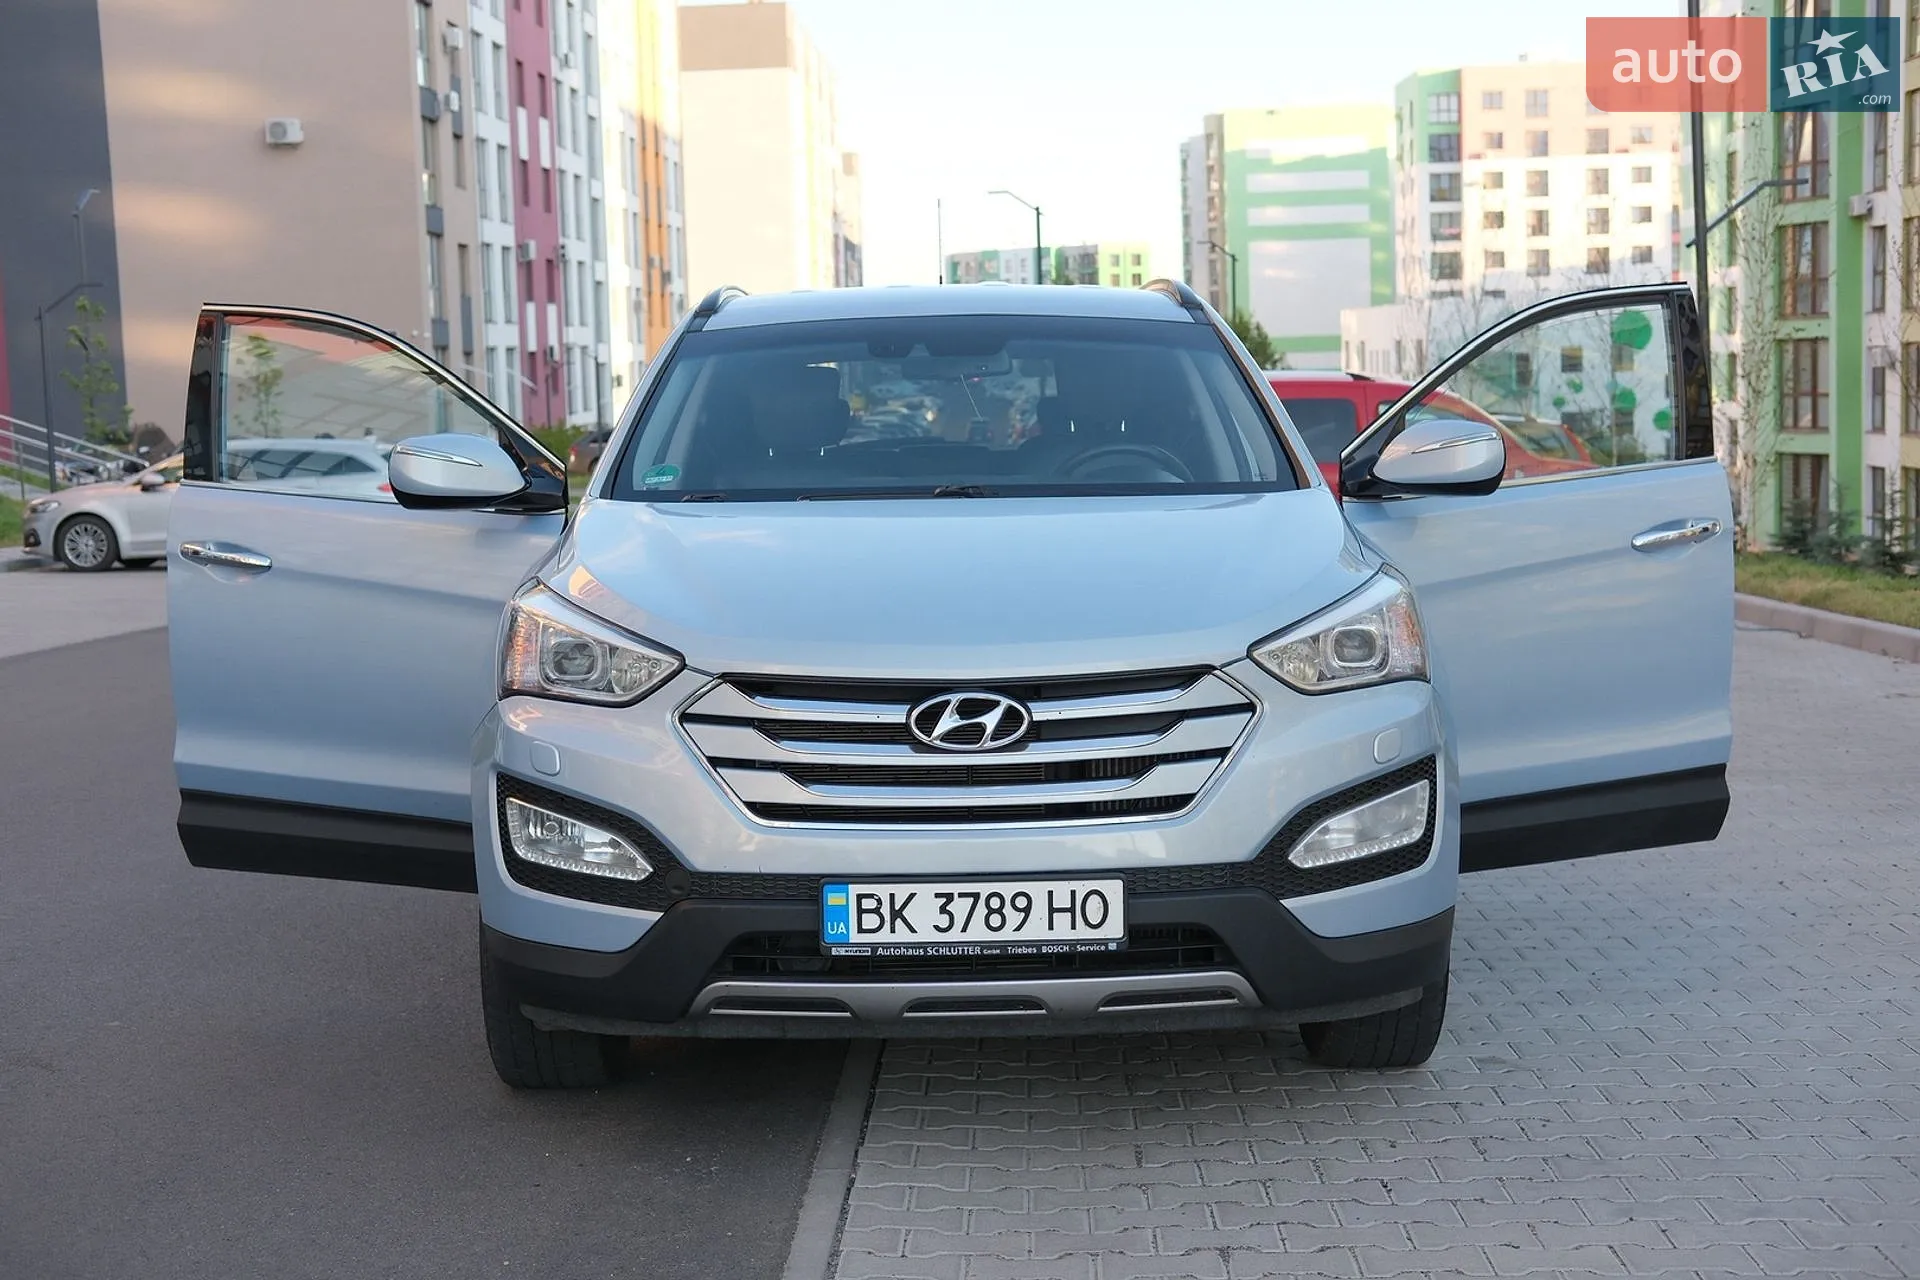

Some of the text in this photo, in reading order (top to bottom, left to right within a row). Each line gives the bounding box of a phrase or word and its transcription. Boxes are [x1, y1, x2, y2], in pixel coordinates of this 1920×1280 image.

[855, 889, 1110, 934] BK 3789 HO
[827, 922, 847, 935] UA
[876, 947, 924, 956] Autohaus
[1007, 946, 1037, 954] Triebes
[1041, 944, 1070, 953] BOSCH
[1076, 944, 1106, 952] Service
